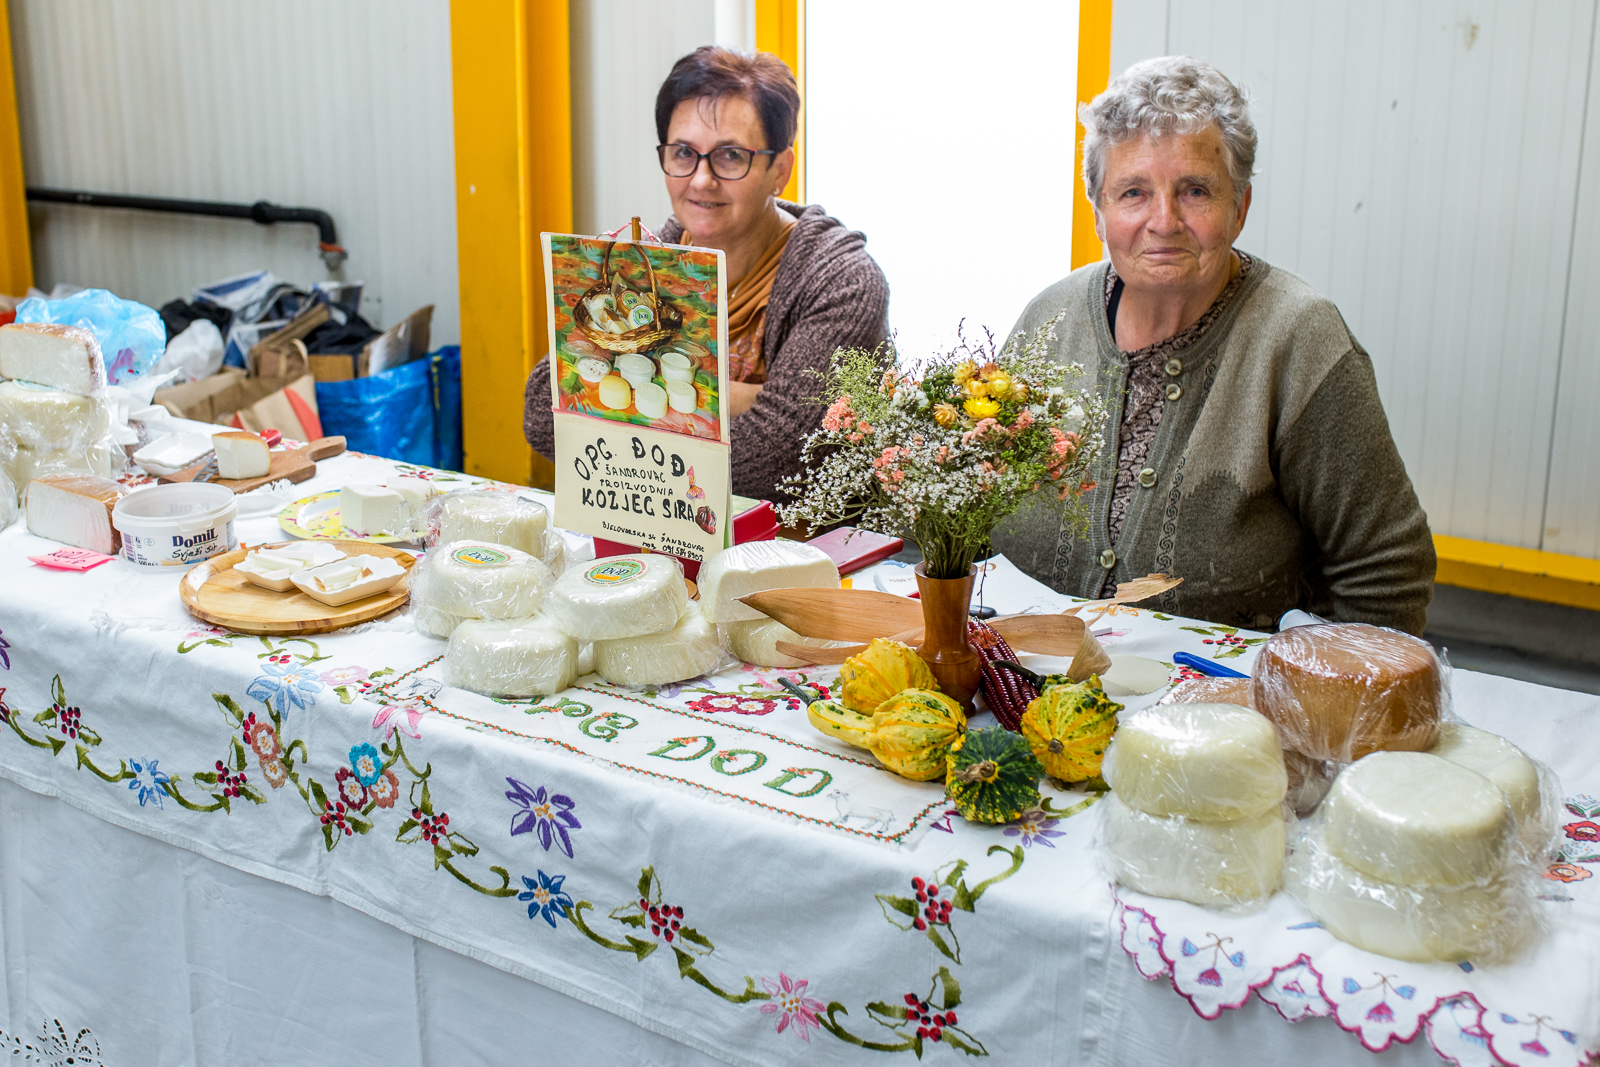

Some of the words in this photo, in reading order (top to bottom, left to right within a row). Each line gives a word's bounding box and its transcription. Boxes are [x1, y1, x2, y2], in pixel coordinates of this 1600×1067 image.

[631, 436, 686, 477] ĐOĐ
[605, 464, 666, 483] ŠANDROVAC
[662, 498, 695, 522] SIRA
